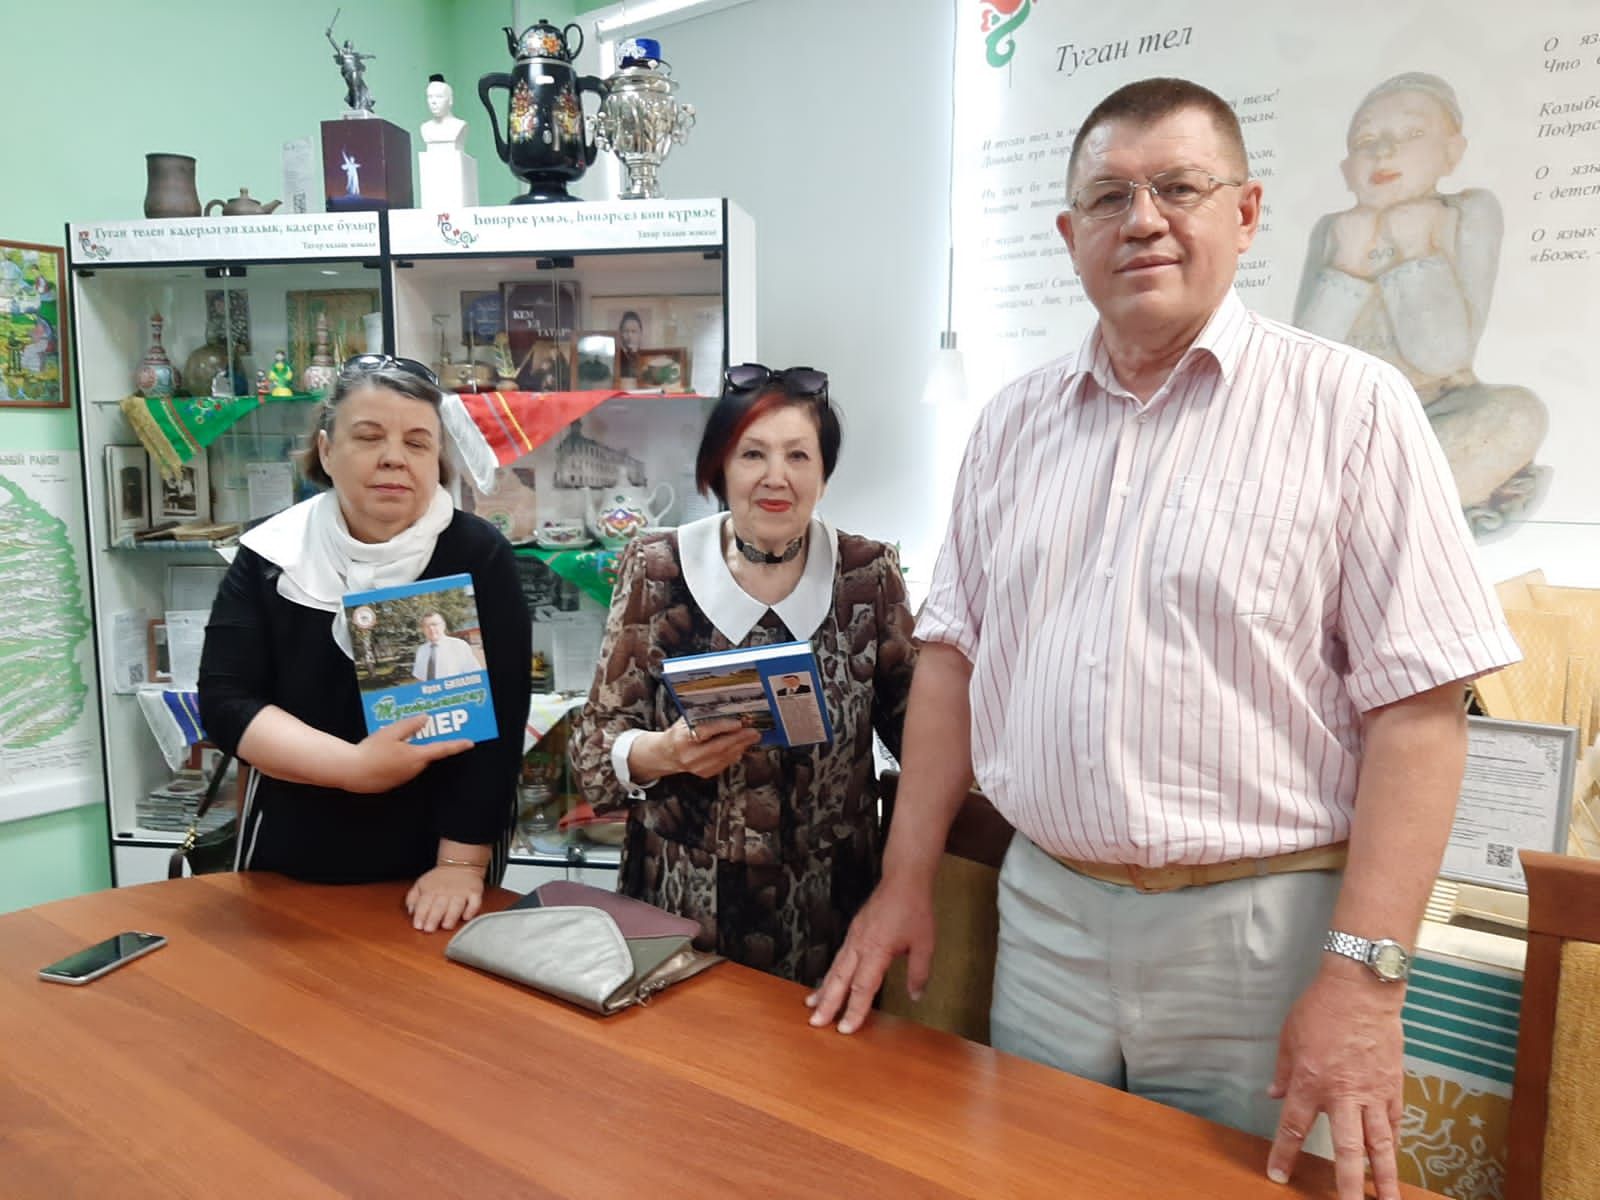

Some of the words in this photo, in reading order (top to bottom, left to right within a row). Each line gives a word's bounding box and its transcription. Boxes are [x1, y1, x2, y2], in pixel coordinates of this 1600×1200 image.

[1544, 37, 1559, 52] О
[1580, 33, 1600, 46] яз
[1056, 40, 1128, 77] Туган
[1138, 27, 1192, 54] тел
[1544, 58, 1581, 73] Что
[1535, 166, 1549, 180] О
[1533, 191, 1543, 201] с
[1531, 228, 1545, 242] О
[1556, 227, 1597, 240] язык
